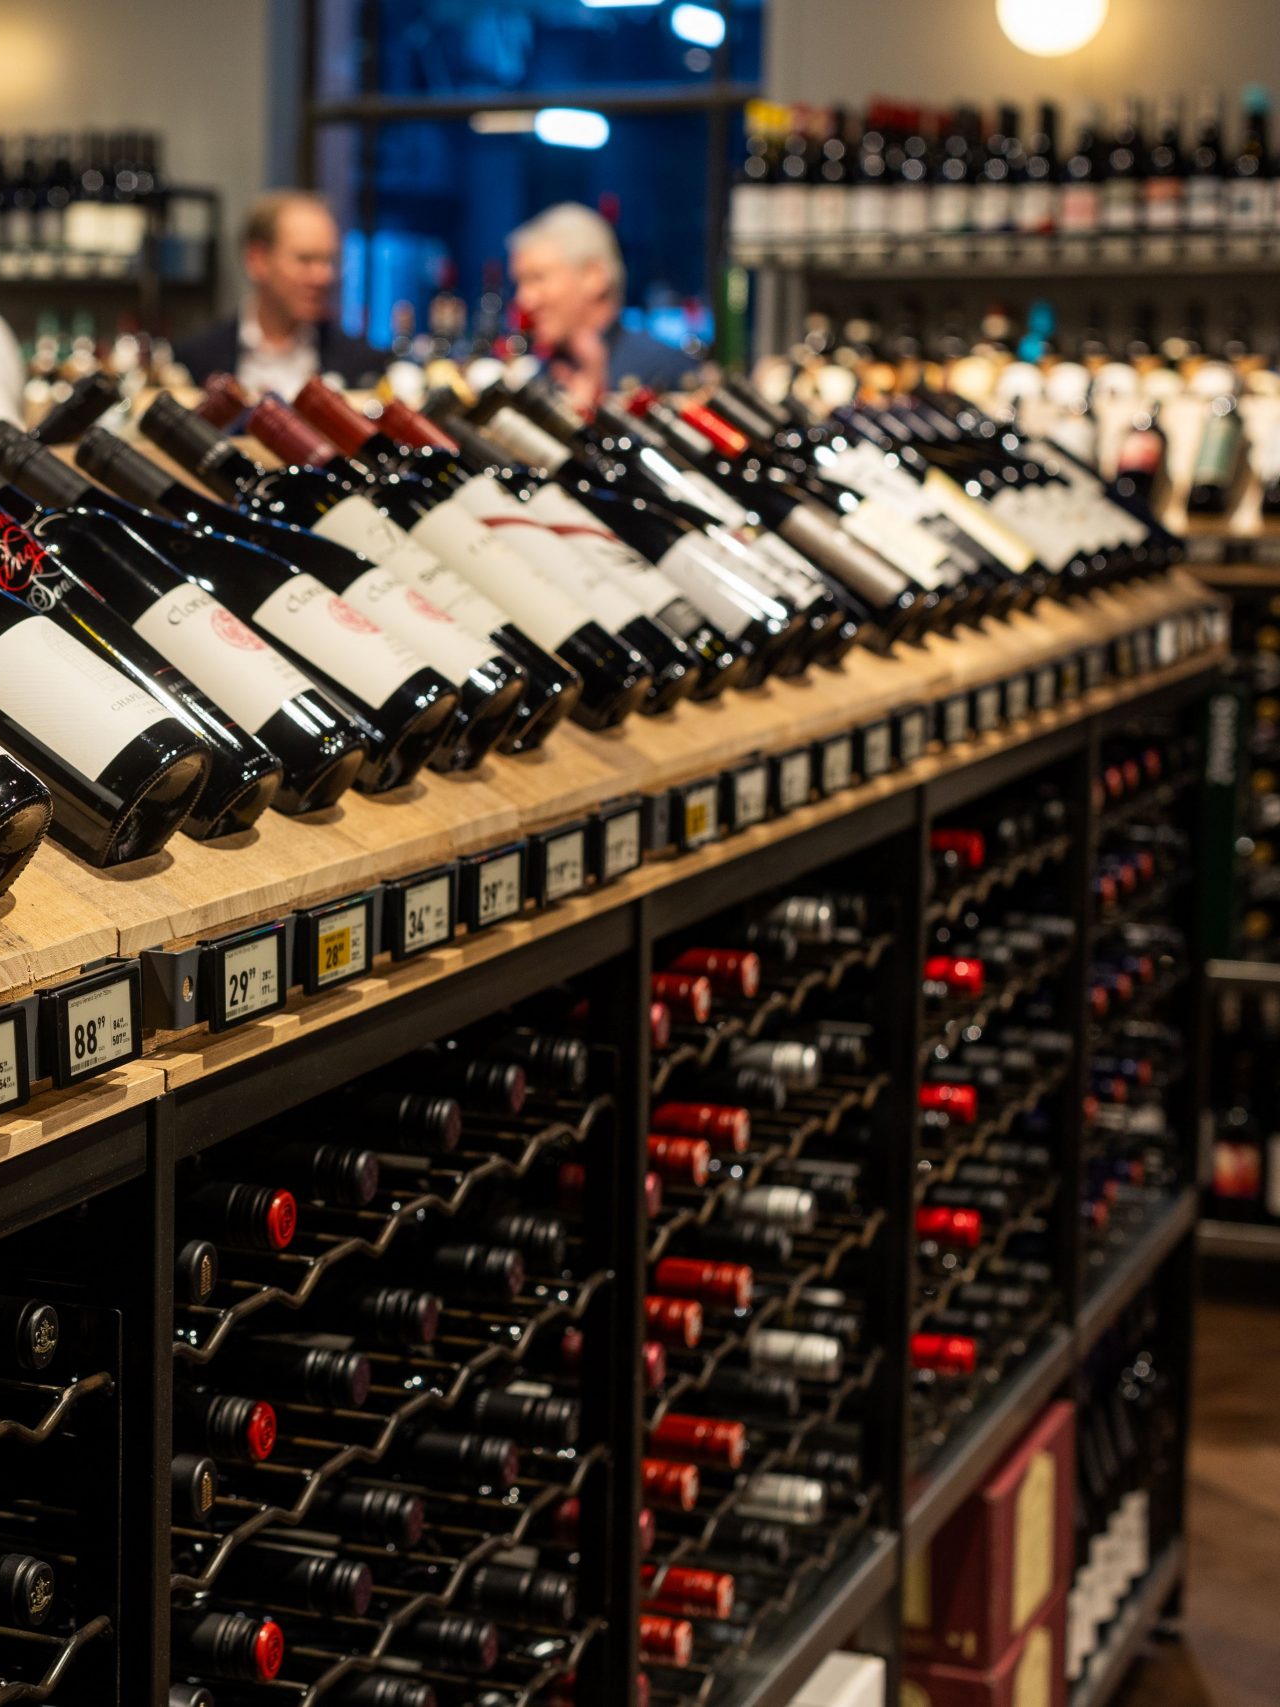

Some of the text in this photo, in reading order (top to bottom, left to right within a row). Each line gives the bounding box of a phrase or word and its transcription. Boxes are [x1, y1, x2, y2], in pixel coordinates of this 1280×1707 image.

[229, 970, 248, 1007] 29
[75, 1015, 106, 1059] 88 99
